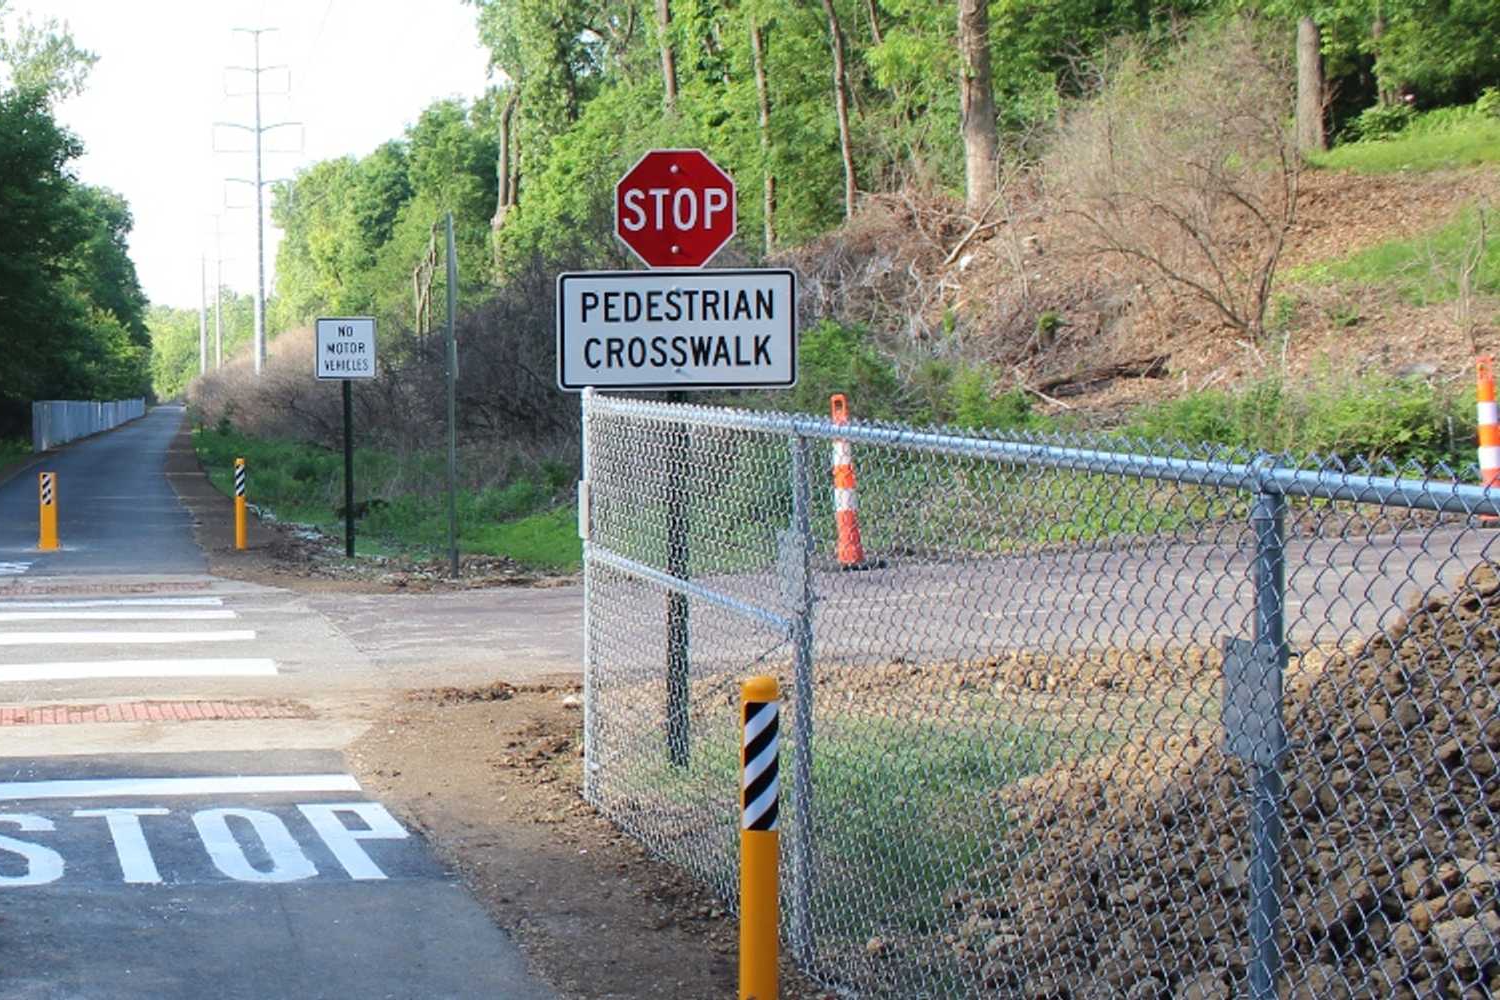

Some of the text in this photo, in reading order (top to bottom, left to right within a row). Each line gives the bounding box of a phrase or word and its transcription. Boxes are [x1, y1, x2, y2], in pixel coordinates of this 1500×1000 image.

[623, 188, 728, 231] STOP
[581, 289, 774, 323] PEDESTRIAN
[337, 326, 354, 338] NO
[326, 342, 366, 354] MOTOR
[584, 335, 772, 368] CROSSWALK
[323, 358, 369, 371] VEHICLES
